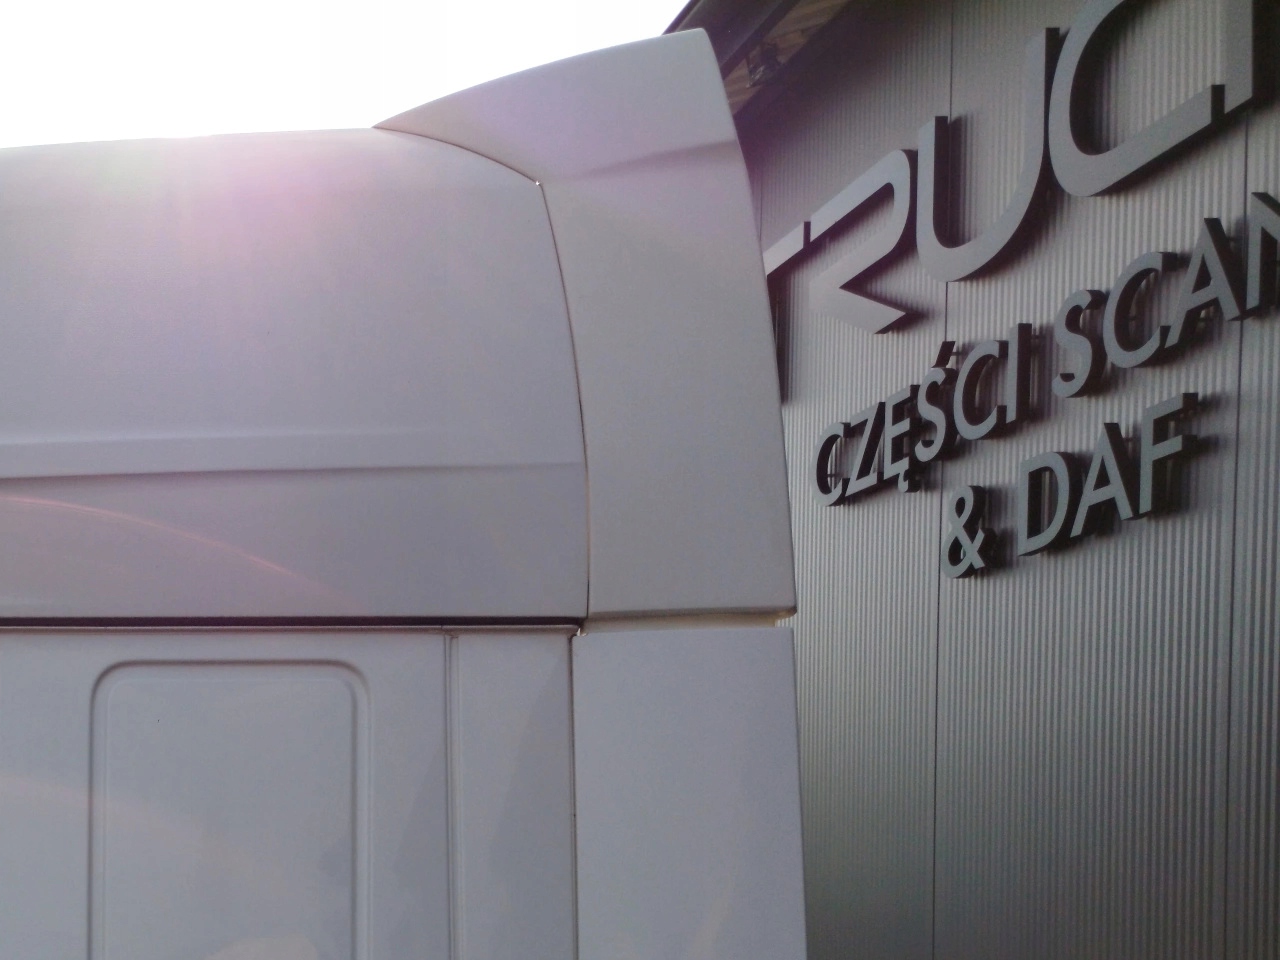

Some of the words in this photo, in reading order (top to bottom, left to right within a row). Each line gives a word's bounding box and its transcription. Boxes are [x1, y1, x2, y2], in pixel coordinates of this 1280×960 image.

[763, 0, 1254, 334] RUC
[814, 323, 1032, 507] CZĘŚCI
[941, 485, 988, 579] &
[1019, 393, 1196, 556] DAF
